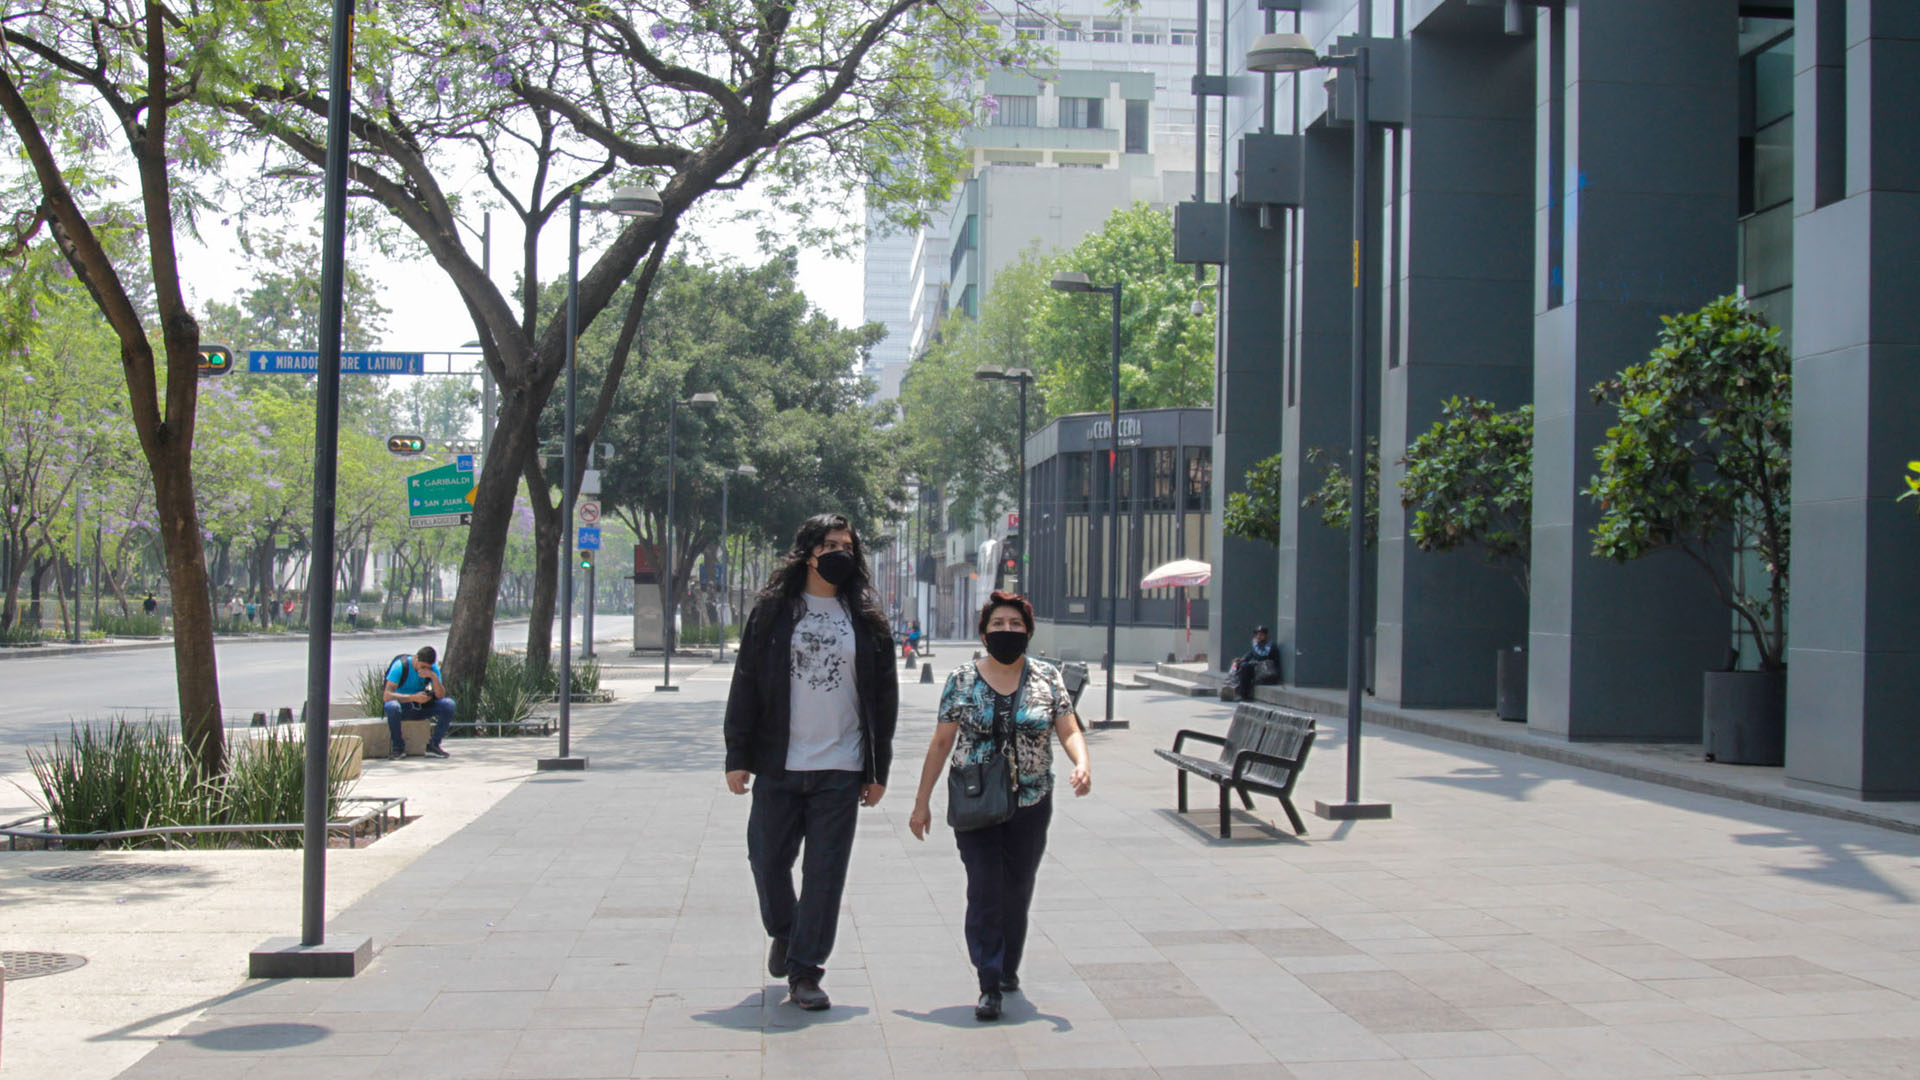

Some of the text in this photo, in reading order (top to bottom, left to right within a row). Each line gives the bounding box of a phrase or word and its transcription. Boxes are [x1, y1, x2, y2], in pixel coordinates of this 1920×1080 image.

[340, 356, 360, 370] RRE
[367, 356, 403, 370] LATINO
[424, 476, 470, 487] GARIBALDI
[424, 499, 439, 507] SAN
[442, 498, 463, 506] JUAN
